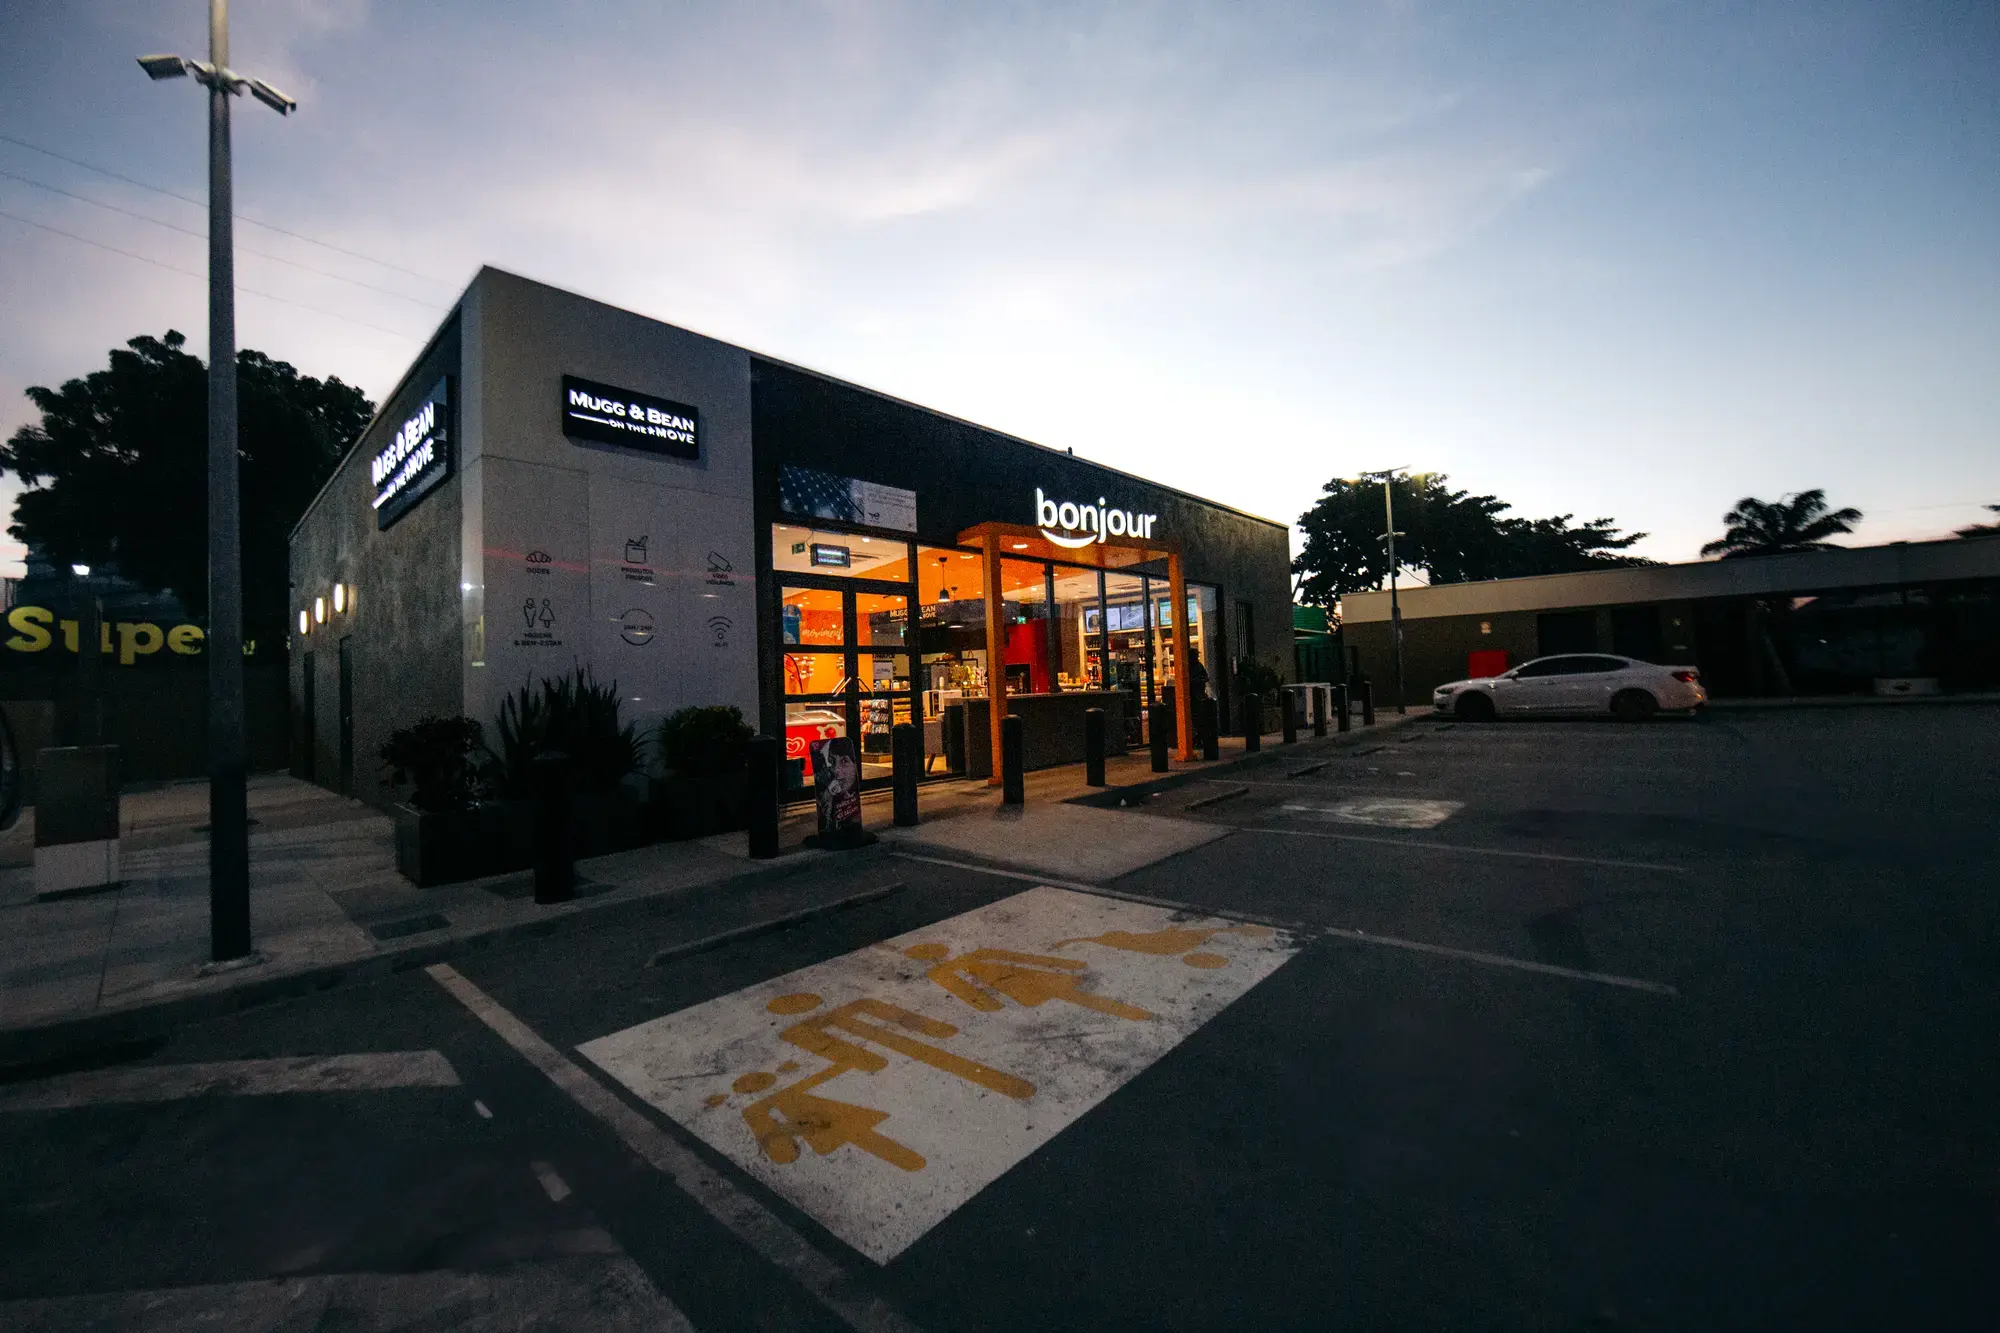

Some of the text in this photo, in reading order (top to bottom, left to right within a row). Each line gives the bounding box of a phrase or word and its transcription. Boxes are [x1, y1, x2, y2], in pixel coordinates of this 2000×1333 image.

[404, 401, 434, 453] BEAN
[569, 388, 695, 432] MUGG & BEAN
[608, 418, 695, 444] ON THE MOVE
[1035, 487, 1157, 544] bonjour
[5, 605, 205, 665] Supe
